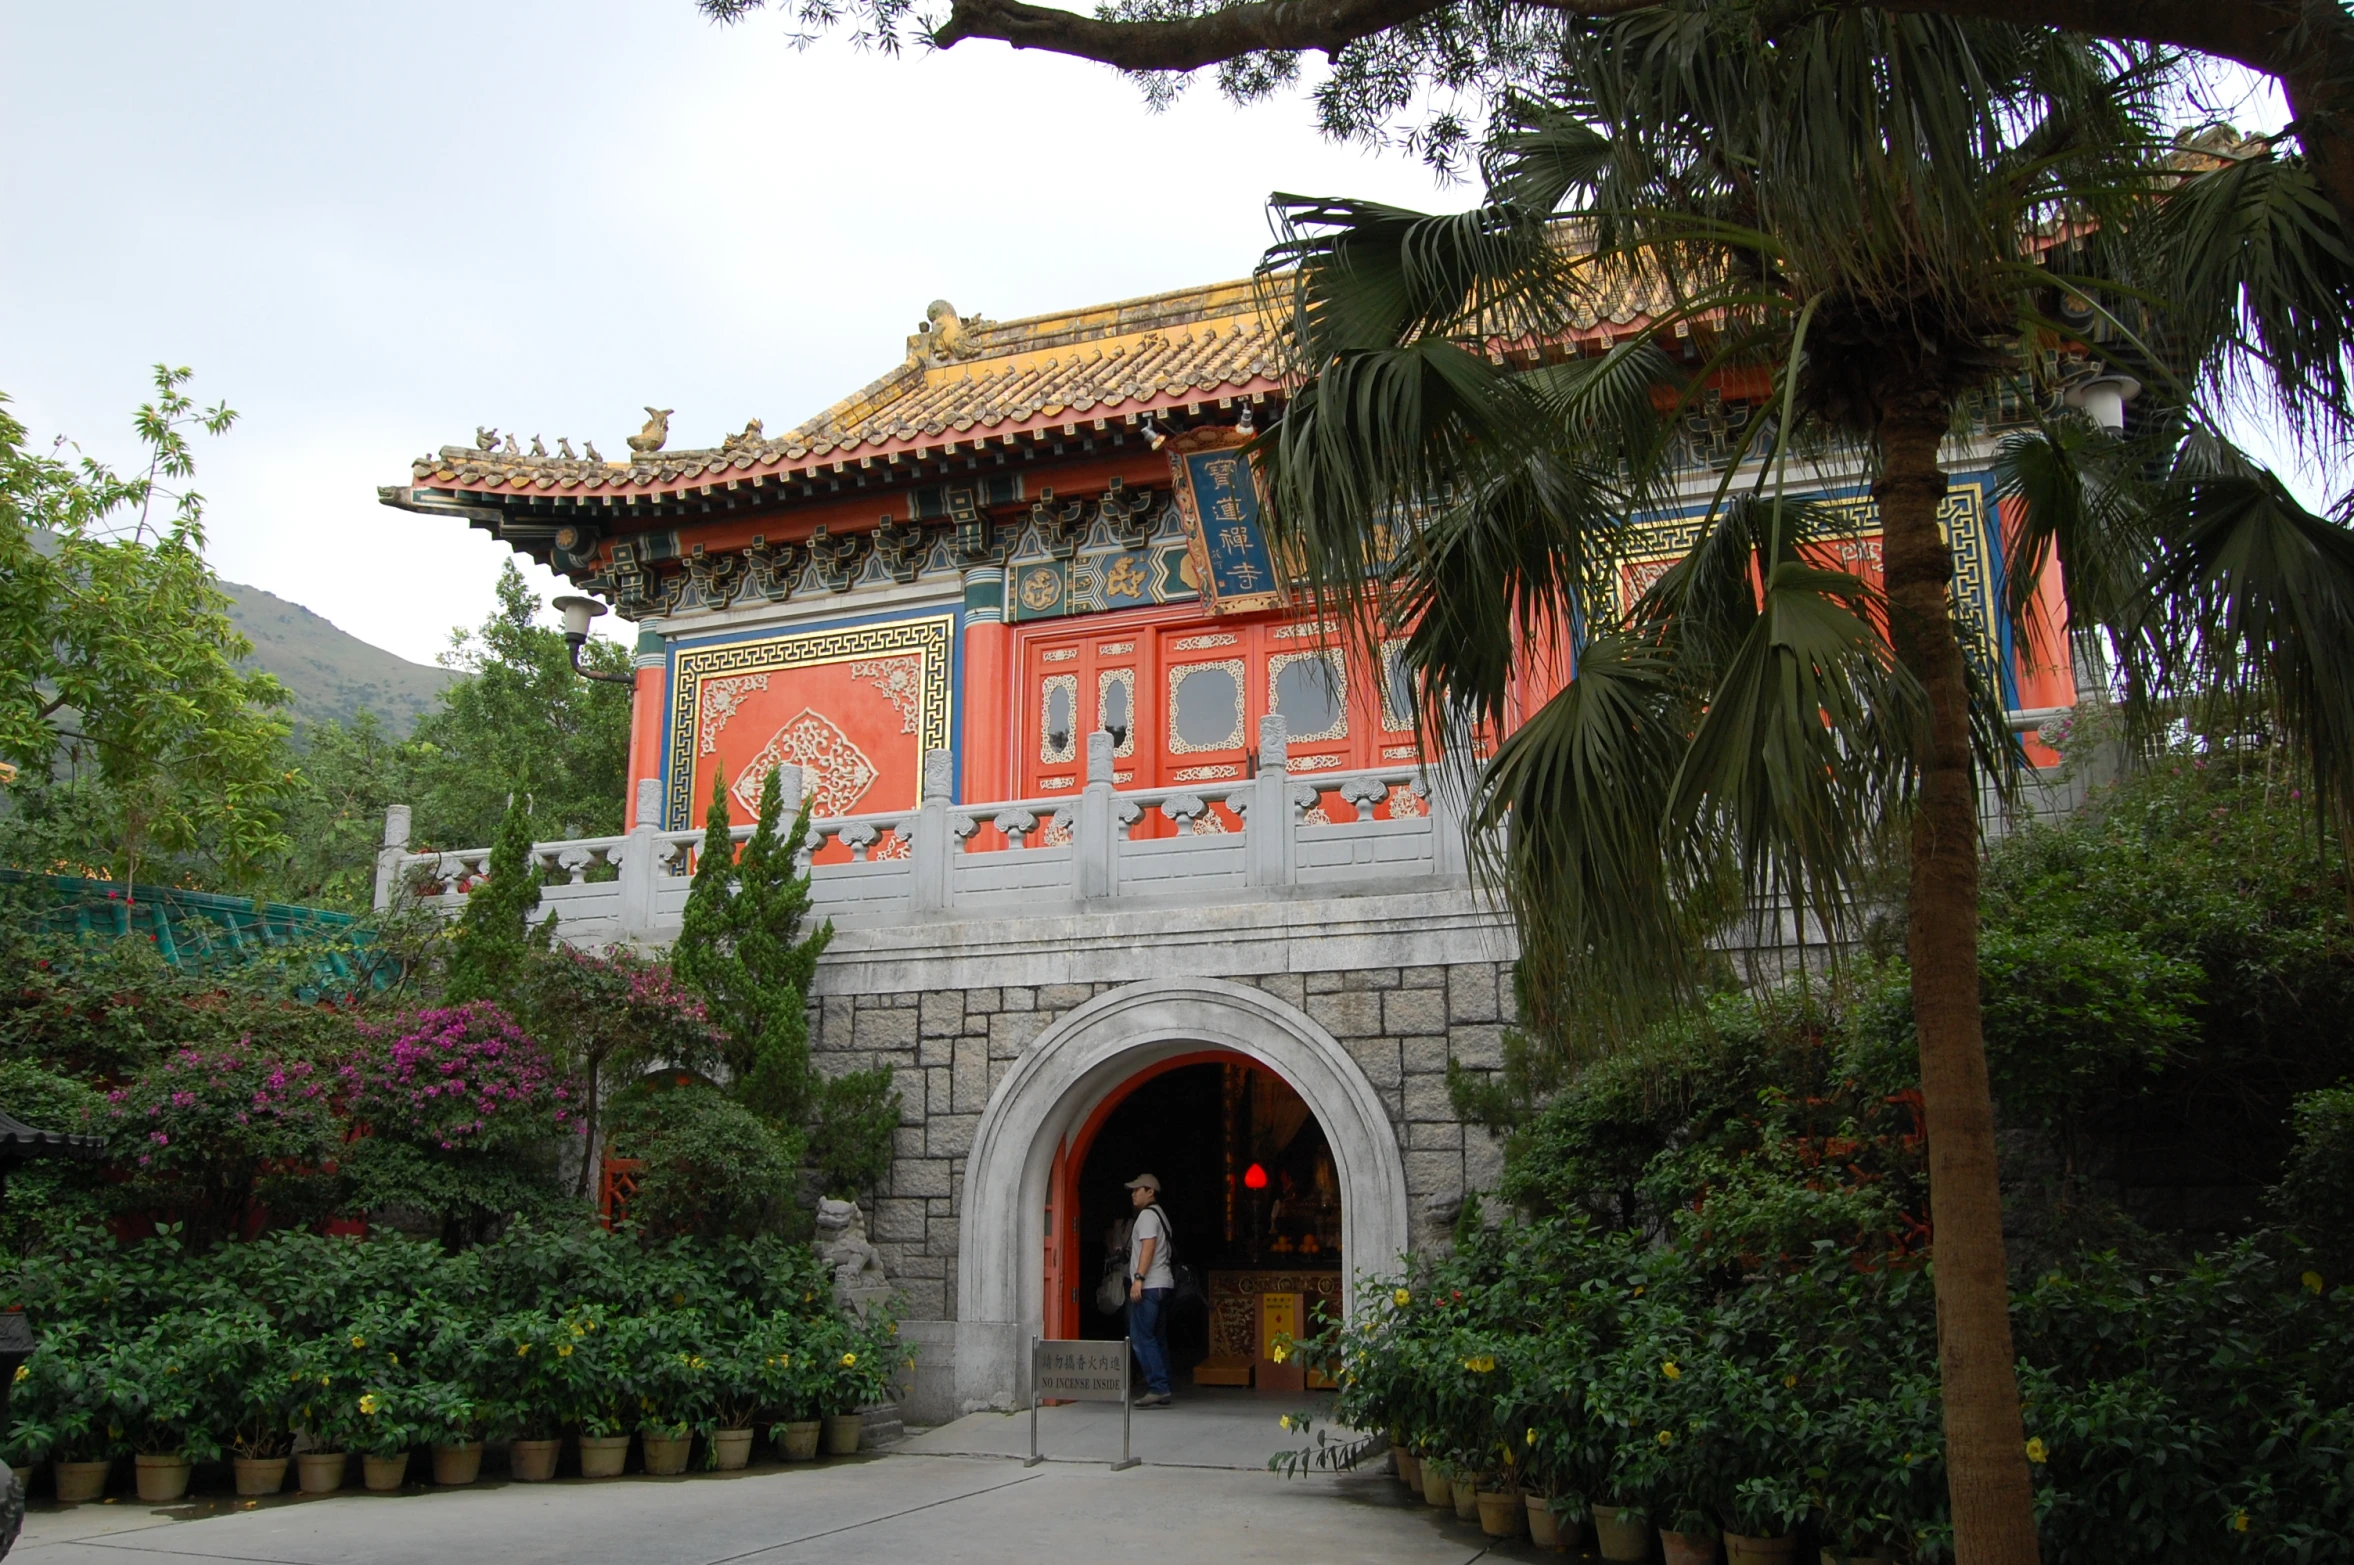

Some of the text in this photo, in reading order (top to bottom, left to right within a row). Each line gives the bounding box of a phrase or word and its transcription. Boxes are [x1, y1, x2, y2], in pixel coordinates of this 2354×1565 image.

[1205, 459, 1263, 590] 寶蓮禪寺
[1042, 1377, 1120, 1391] NO INCENSE INSIDE
